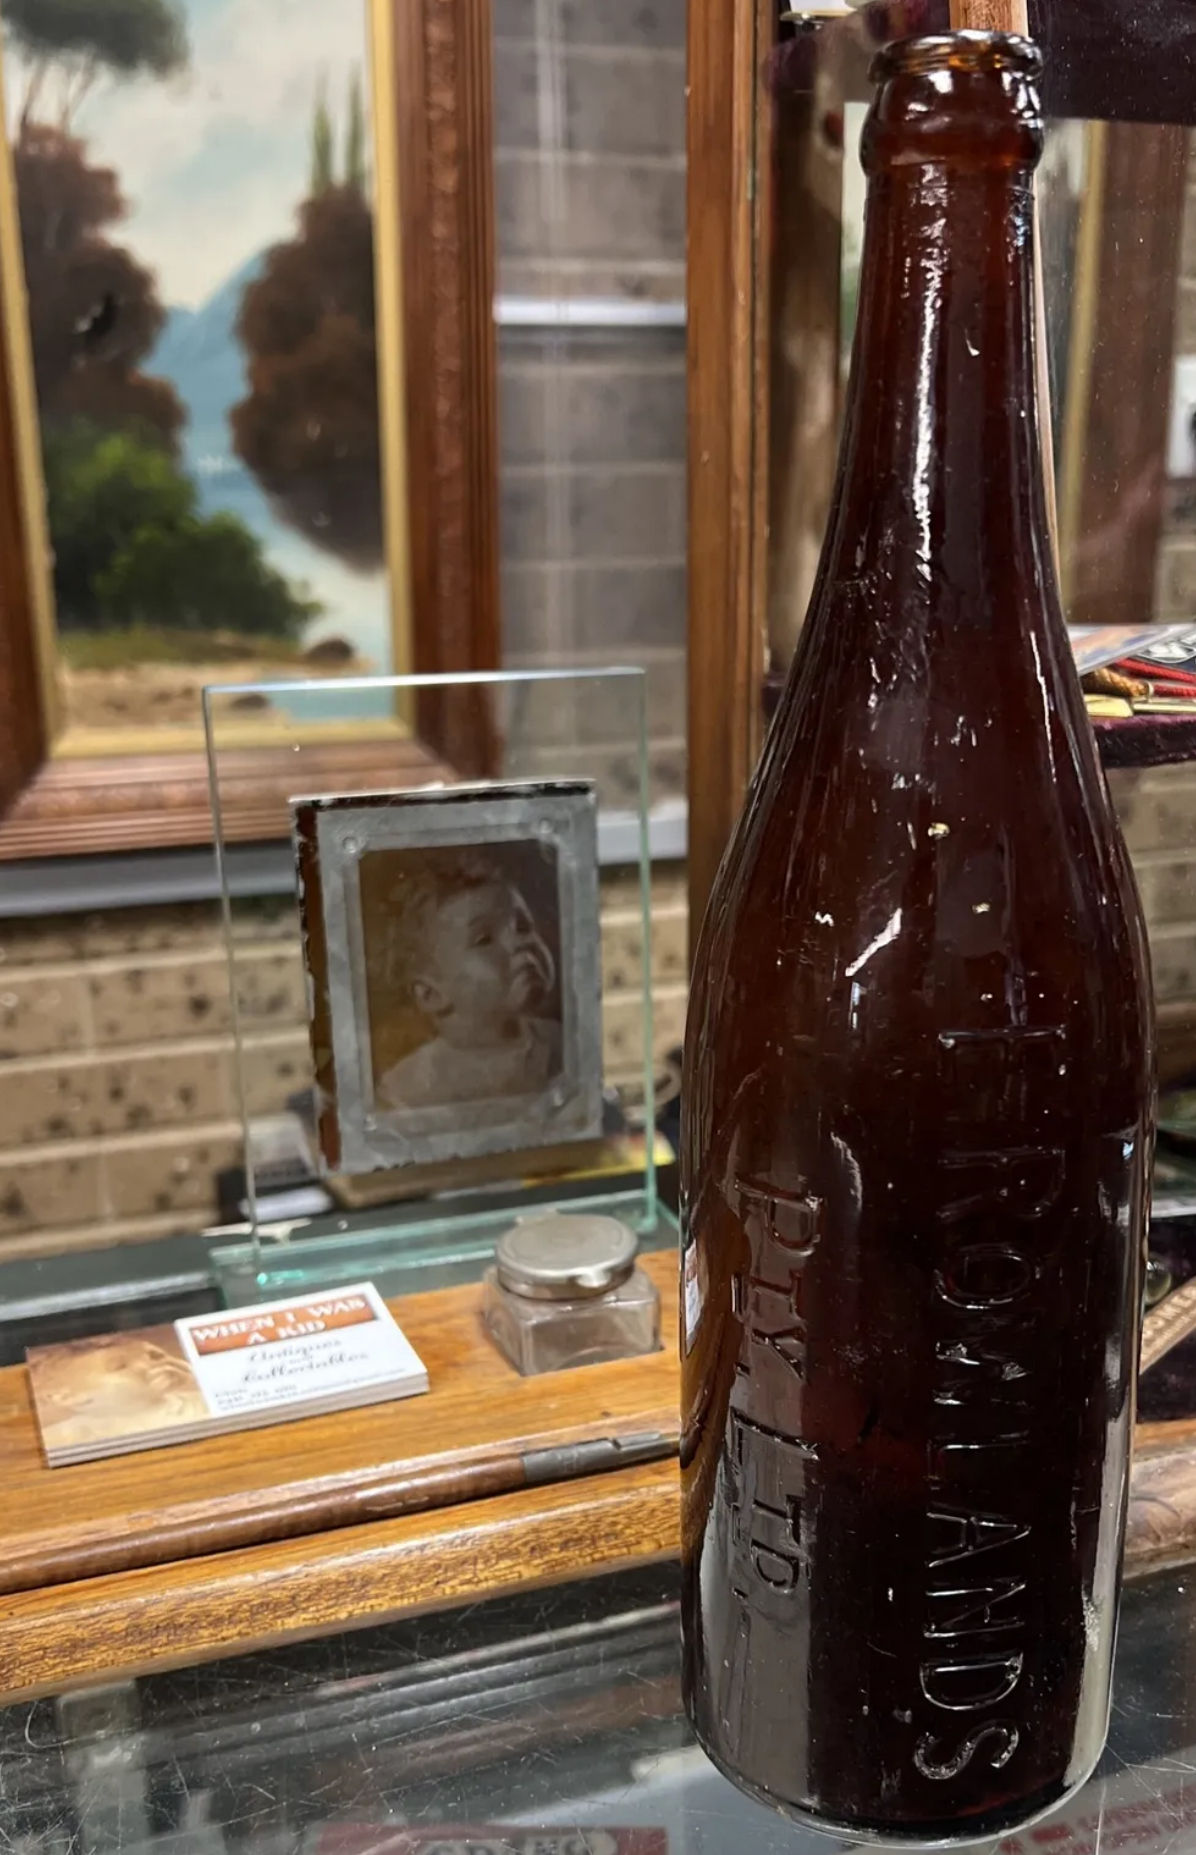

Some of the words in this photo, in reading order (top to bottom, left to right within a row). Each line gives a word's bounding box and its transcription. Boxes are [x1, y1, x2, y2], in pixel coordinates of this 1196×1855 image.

[194, 1316, 274, 1340] WHEN
[285, 1311, 297, 1323] I
[309, 1298, 366, 1317] WAS
[246, 1332, 267, 1345] A
[277, 1320, 326, 1340] KID
[913, 1146, 1068, 1780] ROWLANDS
